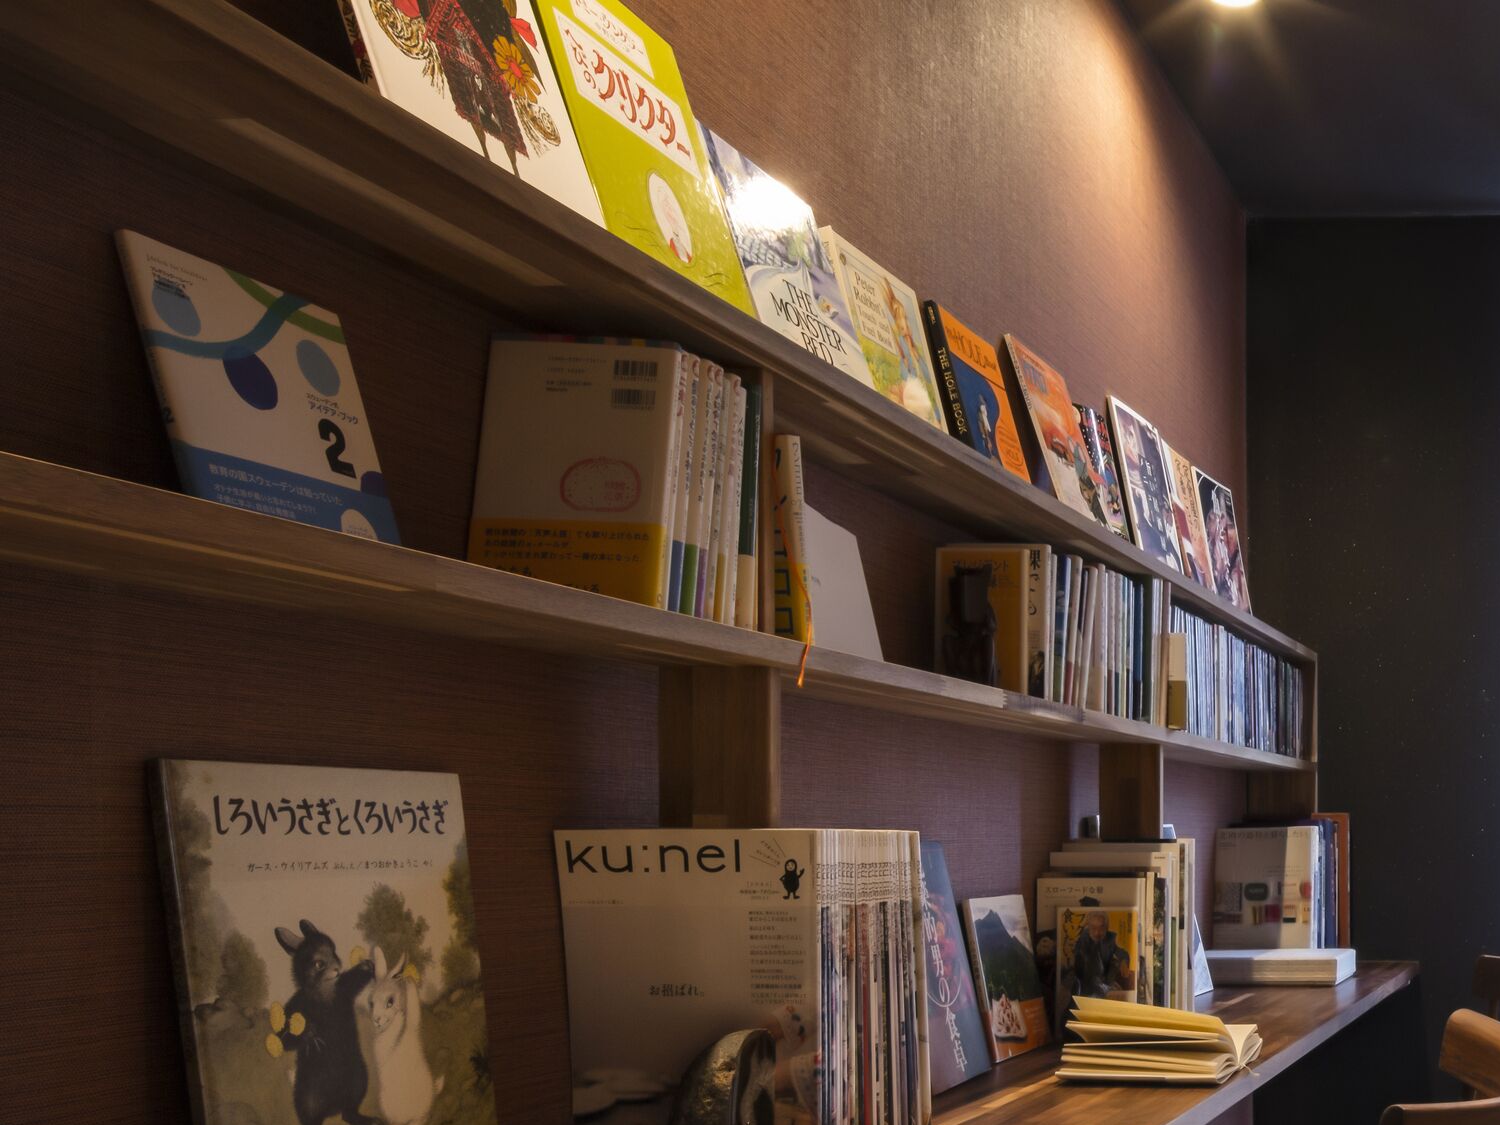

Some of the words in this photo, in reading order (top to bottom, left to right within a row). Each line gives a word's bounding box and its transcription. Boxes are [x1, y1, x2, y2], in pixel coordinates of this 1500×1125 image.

[564, 28, 597, 90] へびの
[591, 48, 692, 161] クリクター
[769, 290, 848, 356] MONSTER
[782, 278, 818, 319] THE
[937, 347, 950, 371] THE
[944, 371, 957, 399] HOLE
[951, 403, 968, 435] BOOK
[317, 417, 357, 480] 2
[211, 793, 449, 836] しろいうさぎとくろいうさぎ
[565, 838, 741, 874] ku:nel
